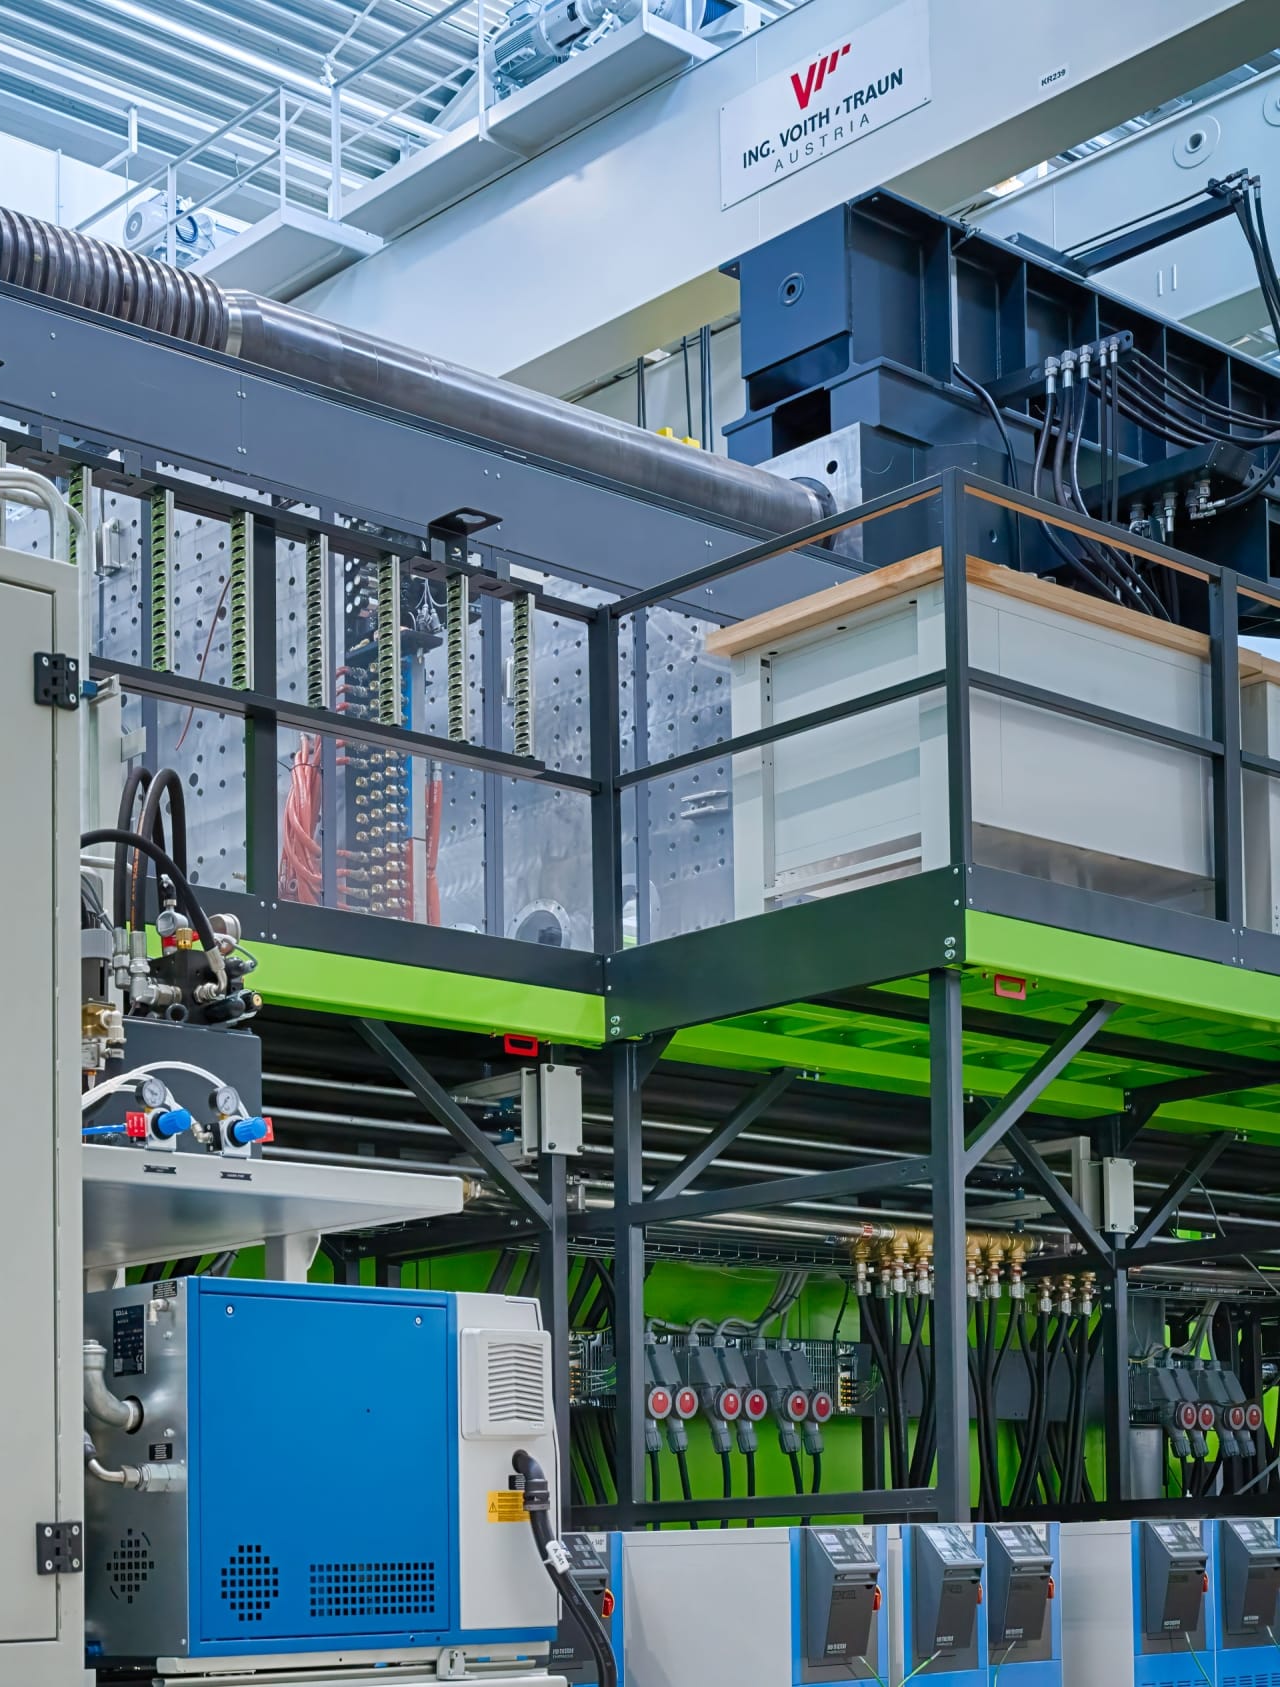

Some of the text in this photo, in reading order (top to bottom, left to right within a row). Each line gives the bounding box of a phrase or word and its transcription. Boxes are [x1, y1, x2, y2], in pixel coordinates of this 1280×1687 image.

[743, 140, 775, 168] ING.
[779, 107, 830, 147] VOITH
[842, 67, 903, 114] TRAUN
[774, 113, 870, 172] AUSTRIA
